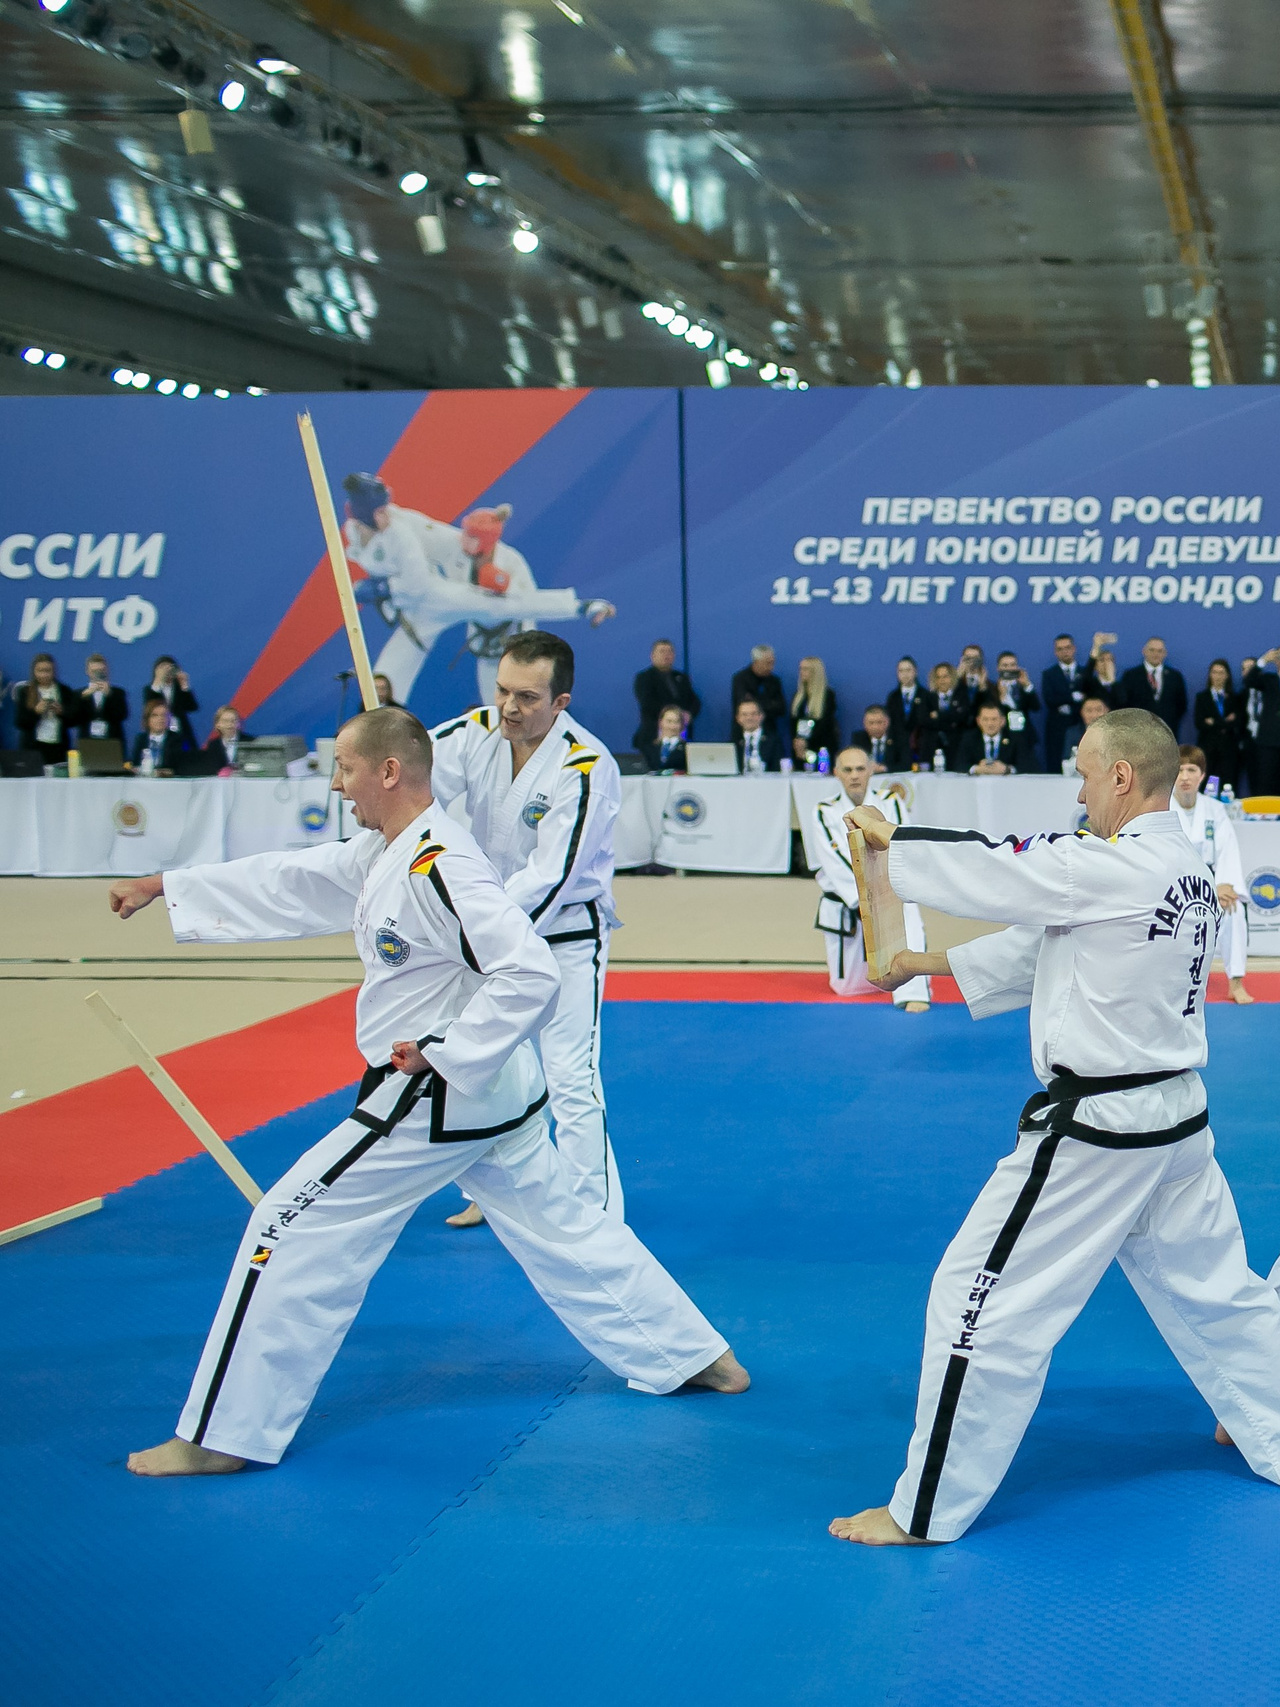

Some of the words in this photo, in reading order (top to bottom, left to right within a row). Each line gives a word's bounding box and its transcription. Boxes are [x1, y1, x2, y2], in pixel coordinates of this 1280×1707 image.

[862, 496, 1101, 525] ПЕРВЕНСТВО
[1110, 496, 1262, 524] РОССИИ
[794, 537, 916, 570] СРЕДИ
[925, 529, 1103, 564] ЮНОШЕЙ
[1112, 536, 1140, 563] И
[881, 576, 955, 603] ЛЕТ
[962, 576, 1017, 603] ПО
[1028, 575, 1263, 608] ТХЭКВОНДО
[18, 594, 158, 644] ИТФ
[1194, 906, 1208, 917] ITF
[303, 1180, 328, 1196] ITF
[975, 1272, 1000, 1288] ITF
